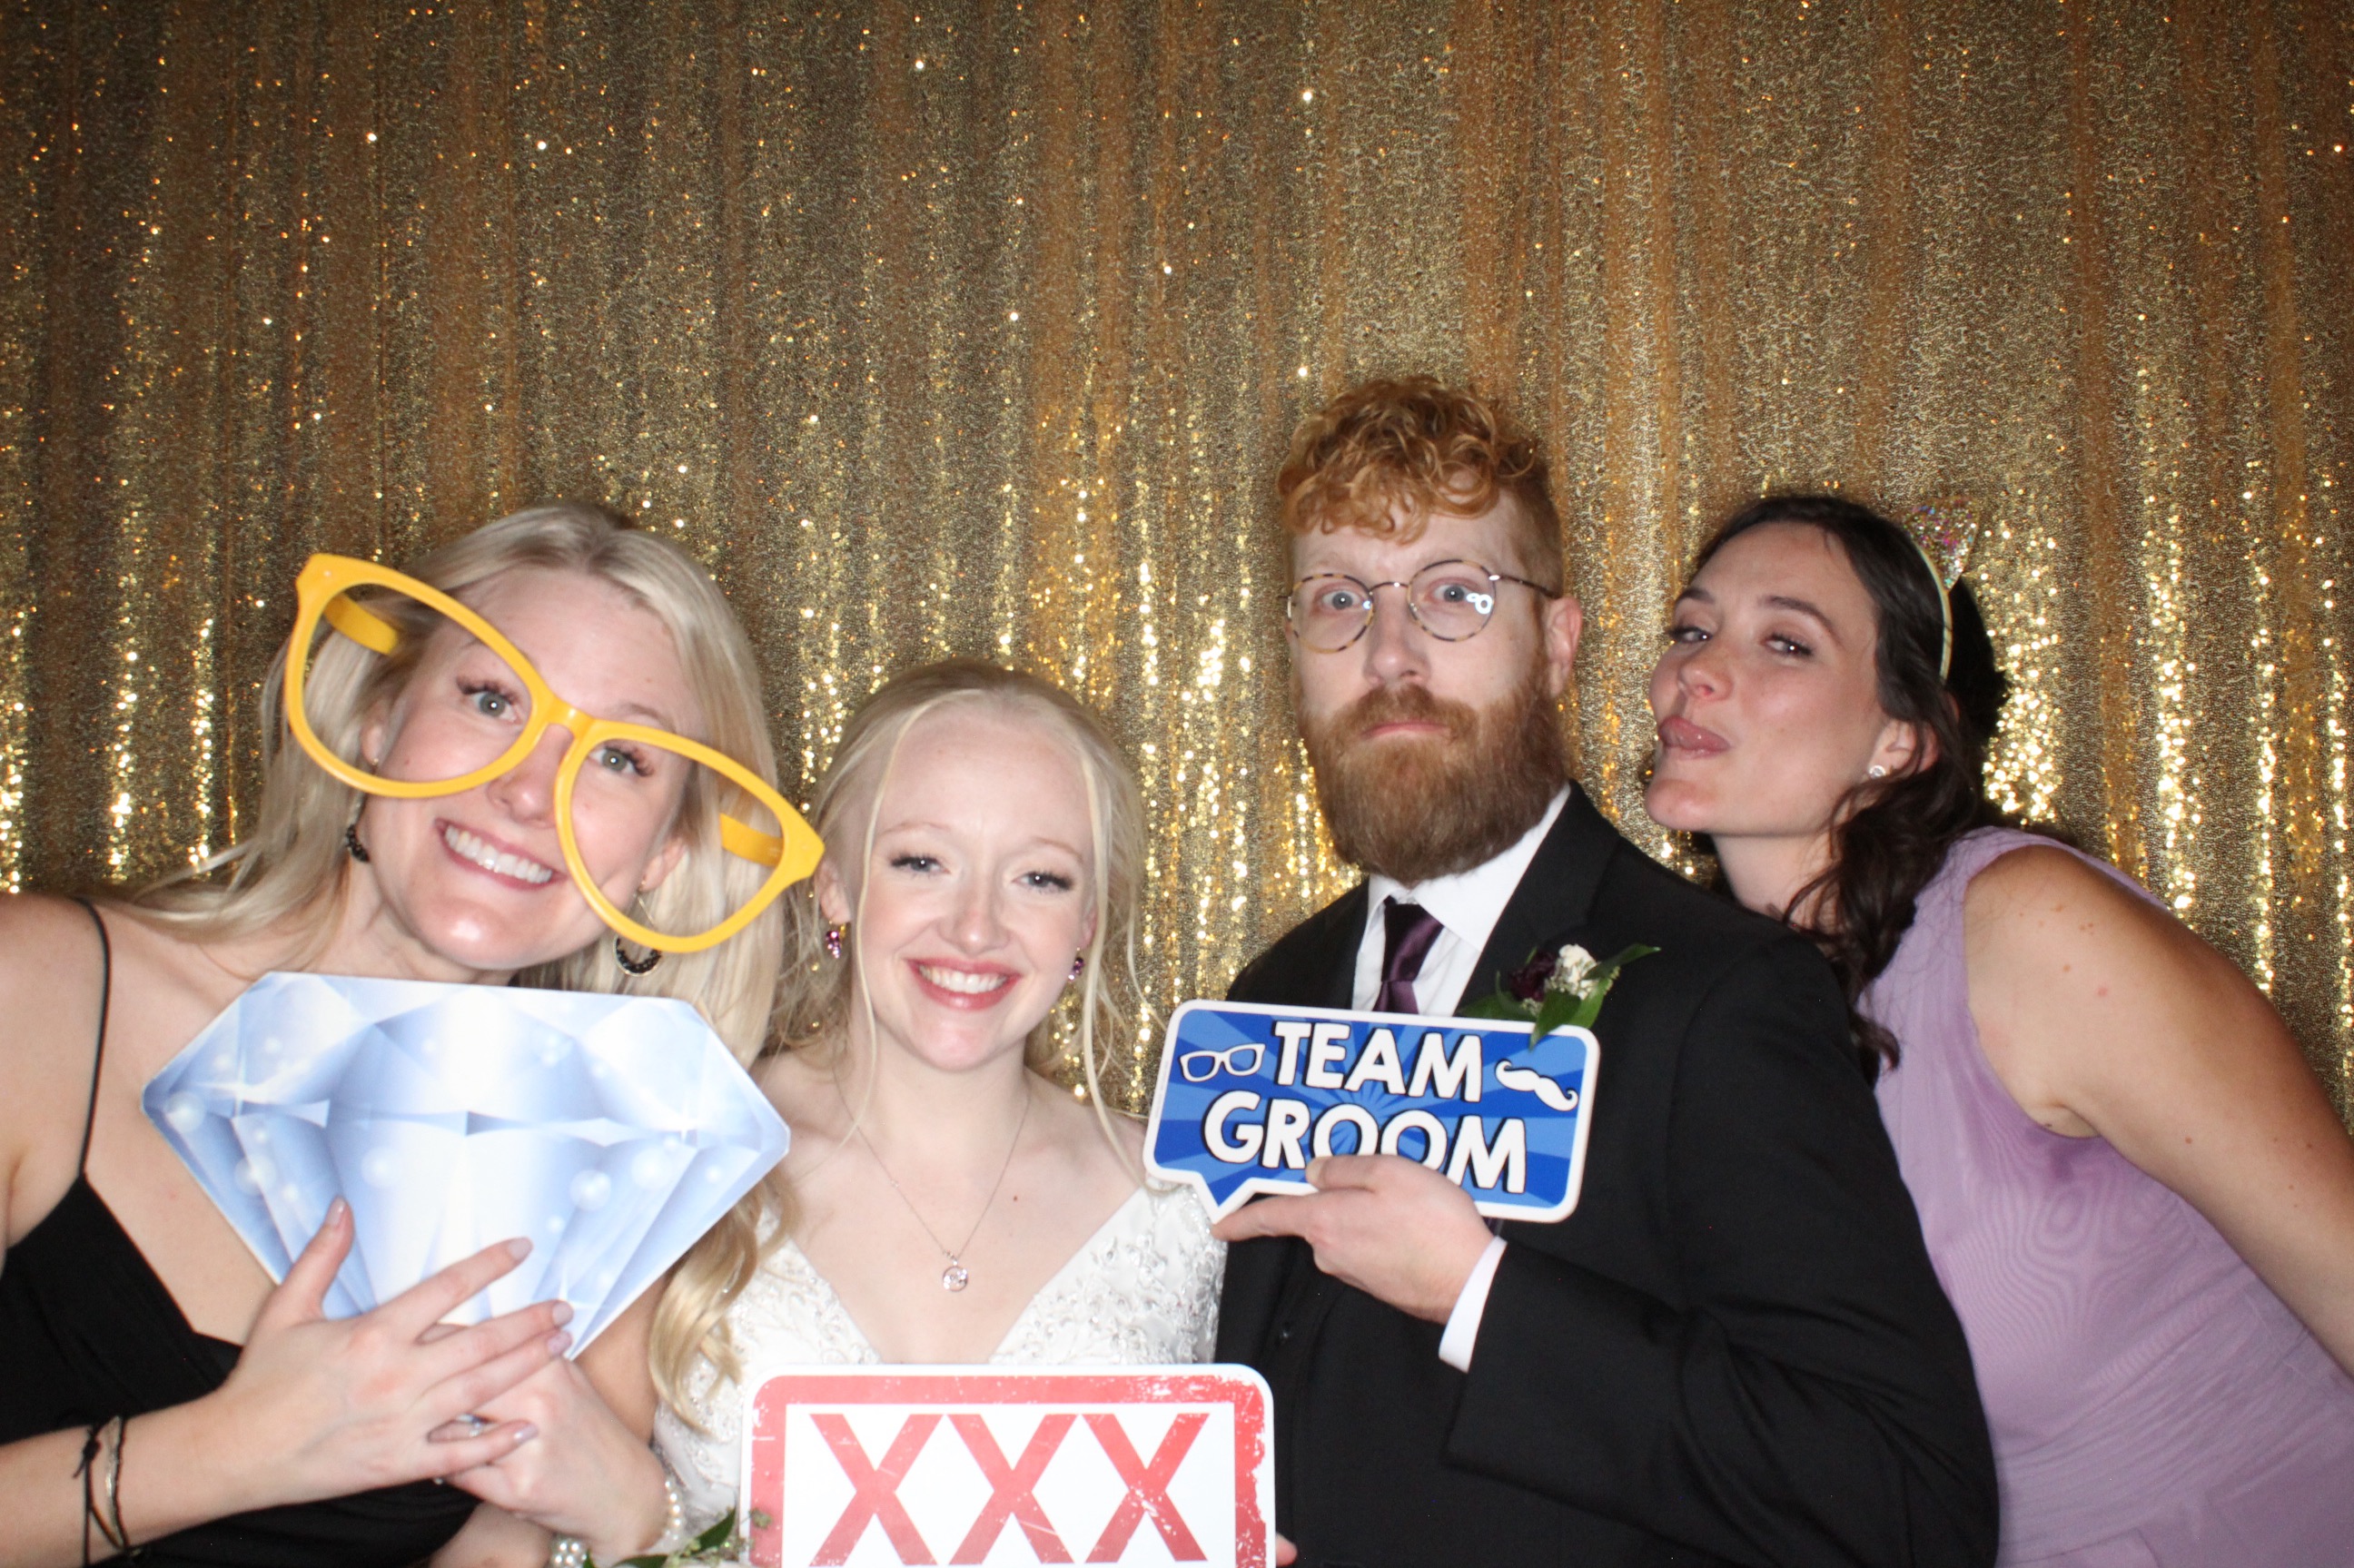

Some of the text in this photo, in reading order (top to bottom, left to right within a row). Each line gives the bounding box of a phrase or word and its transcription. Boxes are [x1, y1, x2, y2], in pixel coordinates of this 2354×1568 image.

[1273, 1021, 1482, 1102] TEAM
[1202, 1090, 1526, 1194] GROOM
[809, 1413, 1210, 1566] XXX
